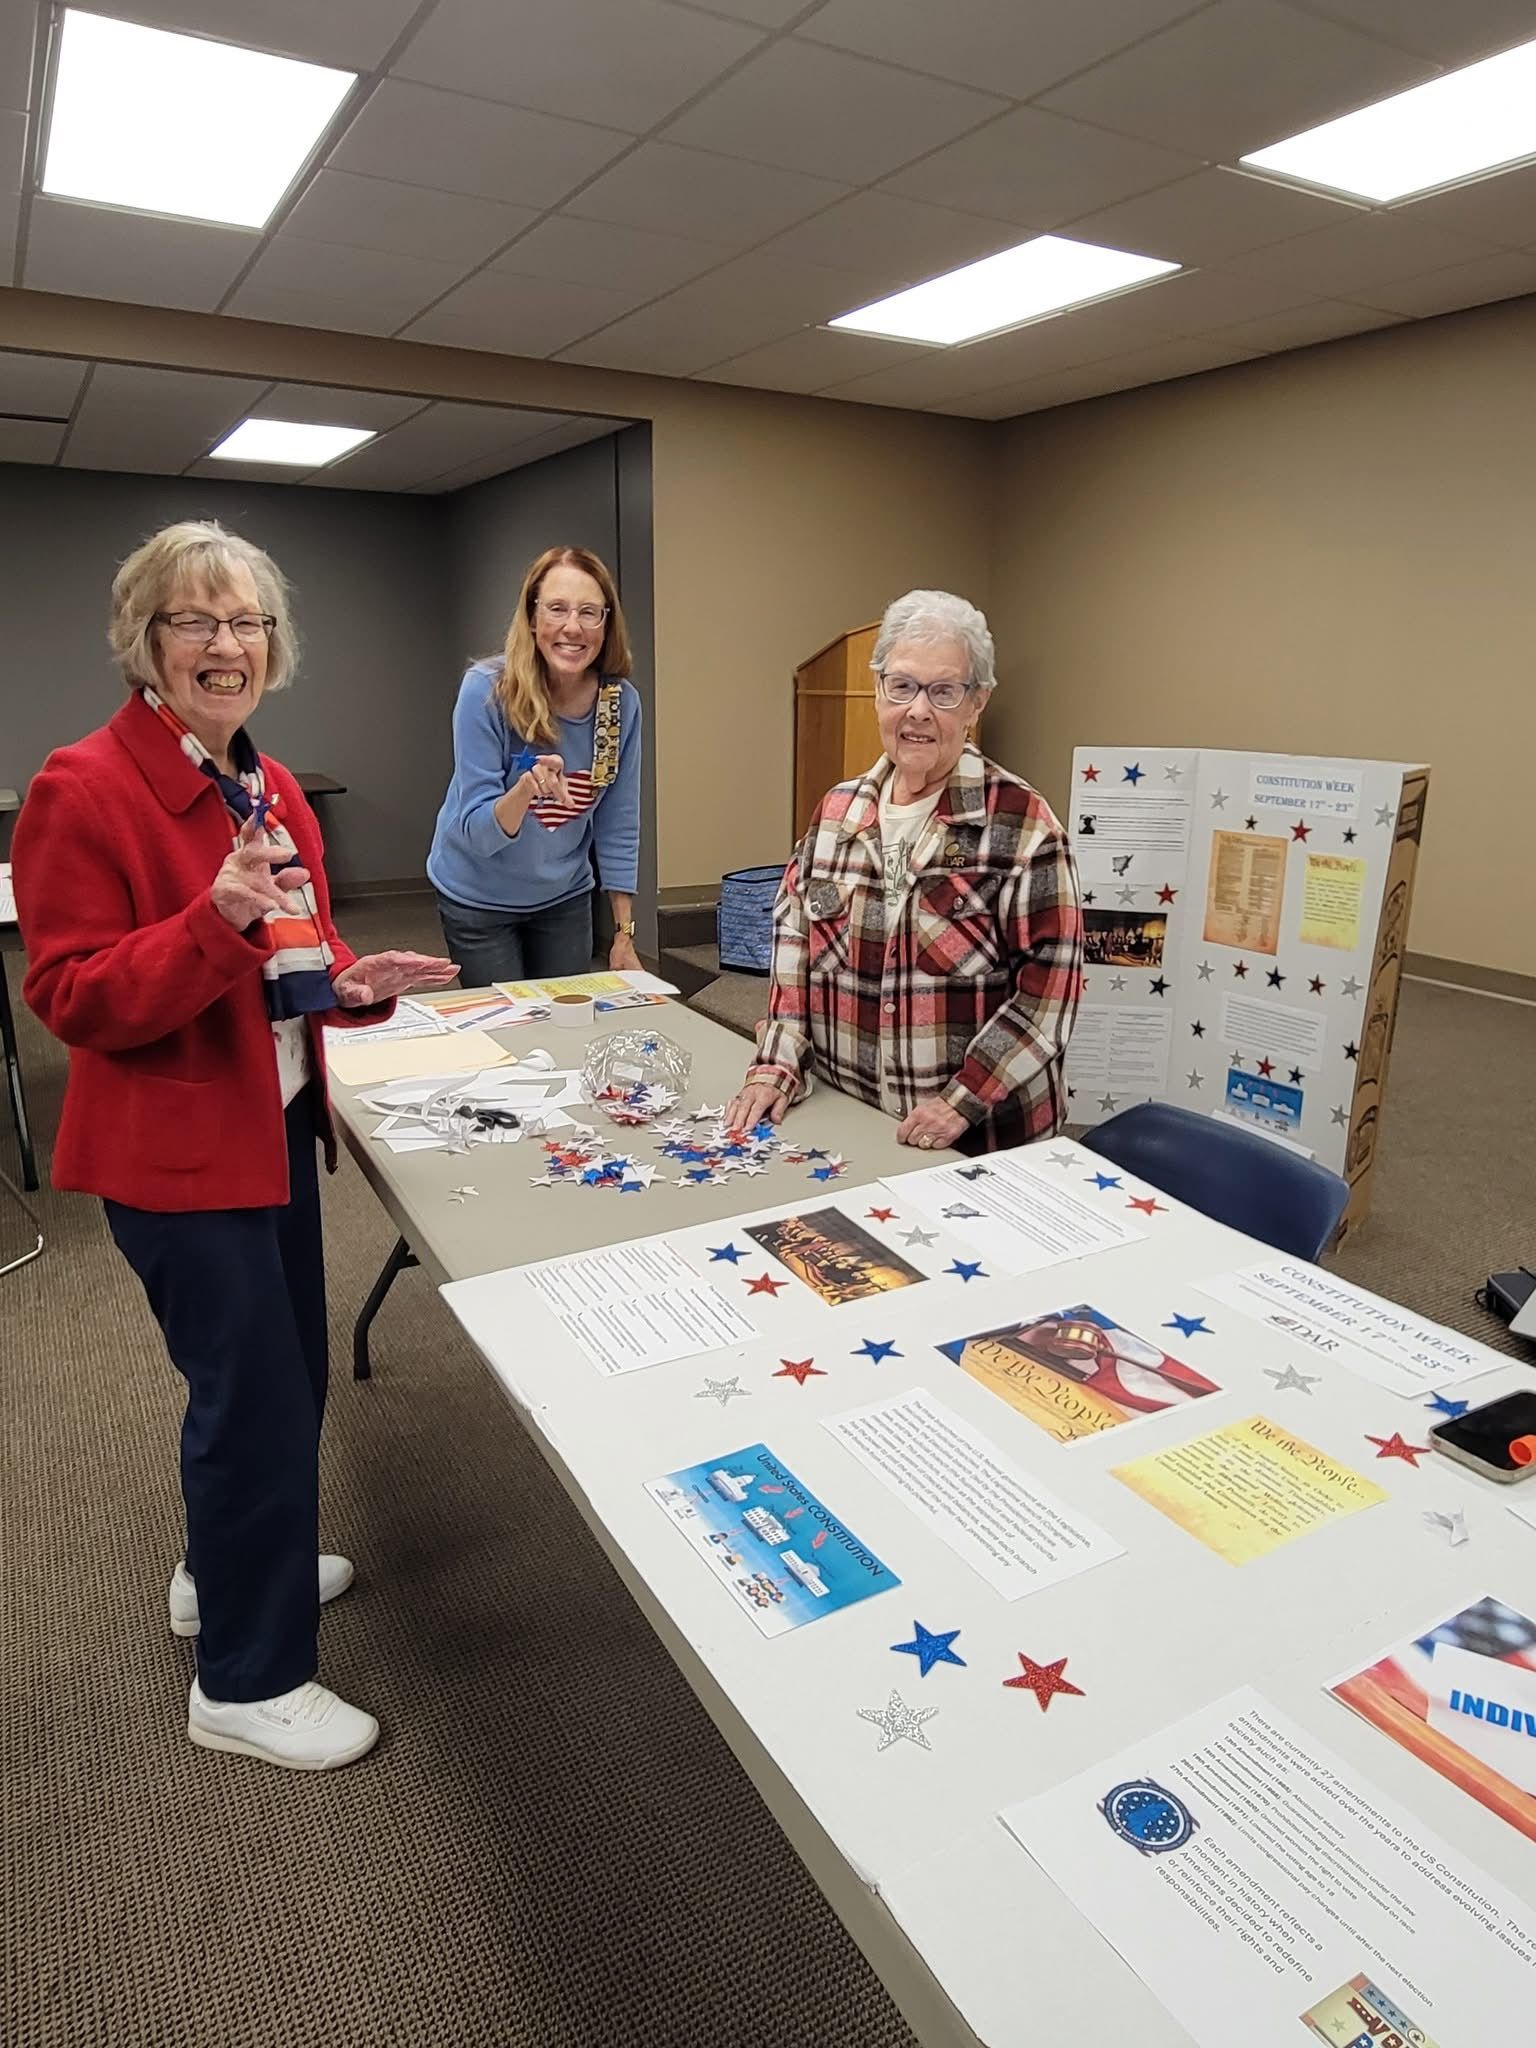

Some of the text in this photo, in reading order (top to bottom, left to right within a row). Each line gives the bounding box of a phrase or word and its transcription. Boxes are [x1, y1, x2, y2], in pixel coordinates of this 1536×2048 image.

[1253, 793, 1307, 808] SEPTEMBER
[1255, 774, 1355, 793] CONSTITUTION WEEK
[1253, 1272, 1357, 1326] SEPTEMBER
[1281, 1266, 1413, 1332] CONSTITUTION
[1413, 1331, 1478, 1364] WEEK
[971, 1336, 1007, 1363] We
[1289, 1324, 1340, 1351] DAR
[1250, 1420, 1276, 1440] We
[756, 1453, 789, 1481] United
[781, 1479, 810, 1505] States
[807, 1504, 883, 1576] CONSTITUTION
[902, 1483, 915, 1493] too
[957, 1477, 985, 1500] Supreme
[982, 1498, 1002, 1514] Court
[998, 1512, 1014, 1524] and
[1011, 1523, 1035, 1542] federal
[964, 1496, 977, 1506] the
[974, 1505, 1007, 1532] separation
[980, 1469, 992, 1479] The
[989, 1477, 1021, 1503] Legislative
[1018, 1502, 1043, 1521] branch
[987, 1489, 1001, 1499] the
[1027, 1523, 1057, 1547] enforces
[1000, 1474, 1038, 1502] government
[1034, 1501, 1048, 1511] are
[1044, 1509, 1059, 1519] the
[939, 1502, 957, 1517] other
[965, 1527, 1001, 1556] preventing
[996, 1555, 1012, 1567] any
[940, 1489, 955, 1501] and
[979, 1524, 1000, 1541] where
[997, 1540, 1015, 1555] each
[1012, 1554, 1037, 1575] branch
[1227, 1722, 1258, 1747] society
[1255, 1745, 1277, 1764] such
[1192, 1770, 1230, 1803] Amendment
[1248, 1818, 1277, 1844] Lowered
[1274, 1841, 1286, 1853] the
[1285, 1851, 1306, 1872] voting
[1303, 1869, 1318, 1882] age
[1235, 1746, 1273, 1778] Amendment
[1291, 1793, 1324, 1821] Abolished
[1322, 1819, 1346, 1840] slavery
[1248, 1709, 1526, 1939] There are currently 27 amendments to the US Constitution. The
[1203, 1764, 1241, 1796] Amendment
[1259, 1812, 1286, 1836] Granted
[1283, 1834, 1308, 1856] women
[1306, 1854, 1320, 1866] the
[1318, 1864, 1335, 1880] right
[1341, 1884, 1358, 1900] vote
[1214, 1758, 1252, 1790] Amendment
[1270, 1806, 1303, 1835] Prohibited
[1301, 1833, 1322, 1852] voting
[1320, 1850, 1368, 1892] discrimination
[1366, 1890, 1390, 1911] based
[1398, 1918, 1416, 1934] race
[1225, 1752, 1263, 1784] Amendment
[1281, 1799, 1319, 1832] Guaranteed
[1316, 1830, 1337, 1848] equal
[1333, 1846, 1370, 1877] protection
[1368, 1875, 1390, 1894] under
[1389, 1892, 1403, 1905] the
[1401, 1903, 1416, 1917] law
[1237, 1716, 1532, 1961] amendments were added over the years to address evolving issues
[1155, 1866, 1220, 1932] responsibilities.
[1167, 1858, 1285, 1974] or reinforce their rights and
[1179, 1851, 1313, 1982] Americans decided to redefine
[1182, 1776, 1219, 1809] Amendment
[1236, 1825, 1257, 1844] Limits
[1255, 1842, 1301, 1883] congressional
[1296, 1881, 1313, 1894] pay
[1310, 1893, 1340, 1920] changes
[1338, 1919, 1357, 1936] until
[1354, 1934, 1374, 1951] after
[1372, 1949, 1386, 1963] the
[1384, 1961, 1403, 1978] next
[1401, 1977, 1433, 2007] election
[1191, 1844, 1295, 1944] moment in history when
[1203, 1836, 1323, 1952] Each amendment reflects a
